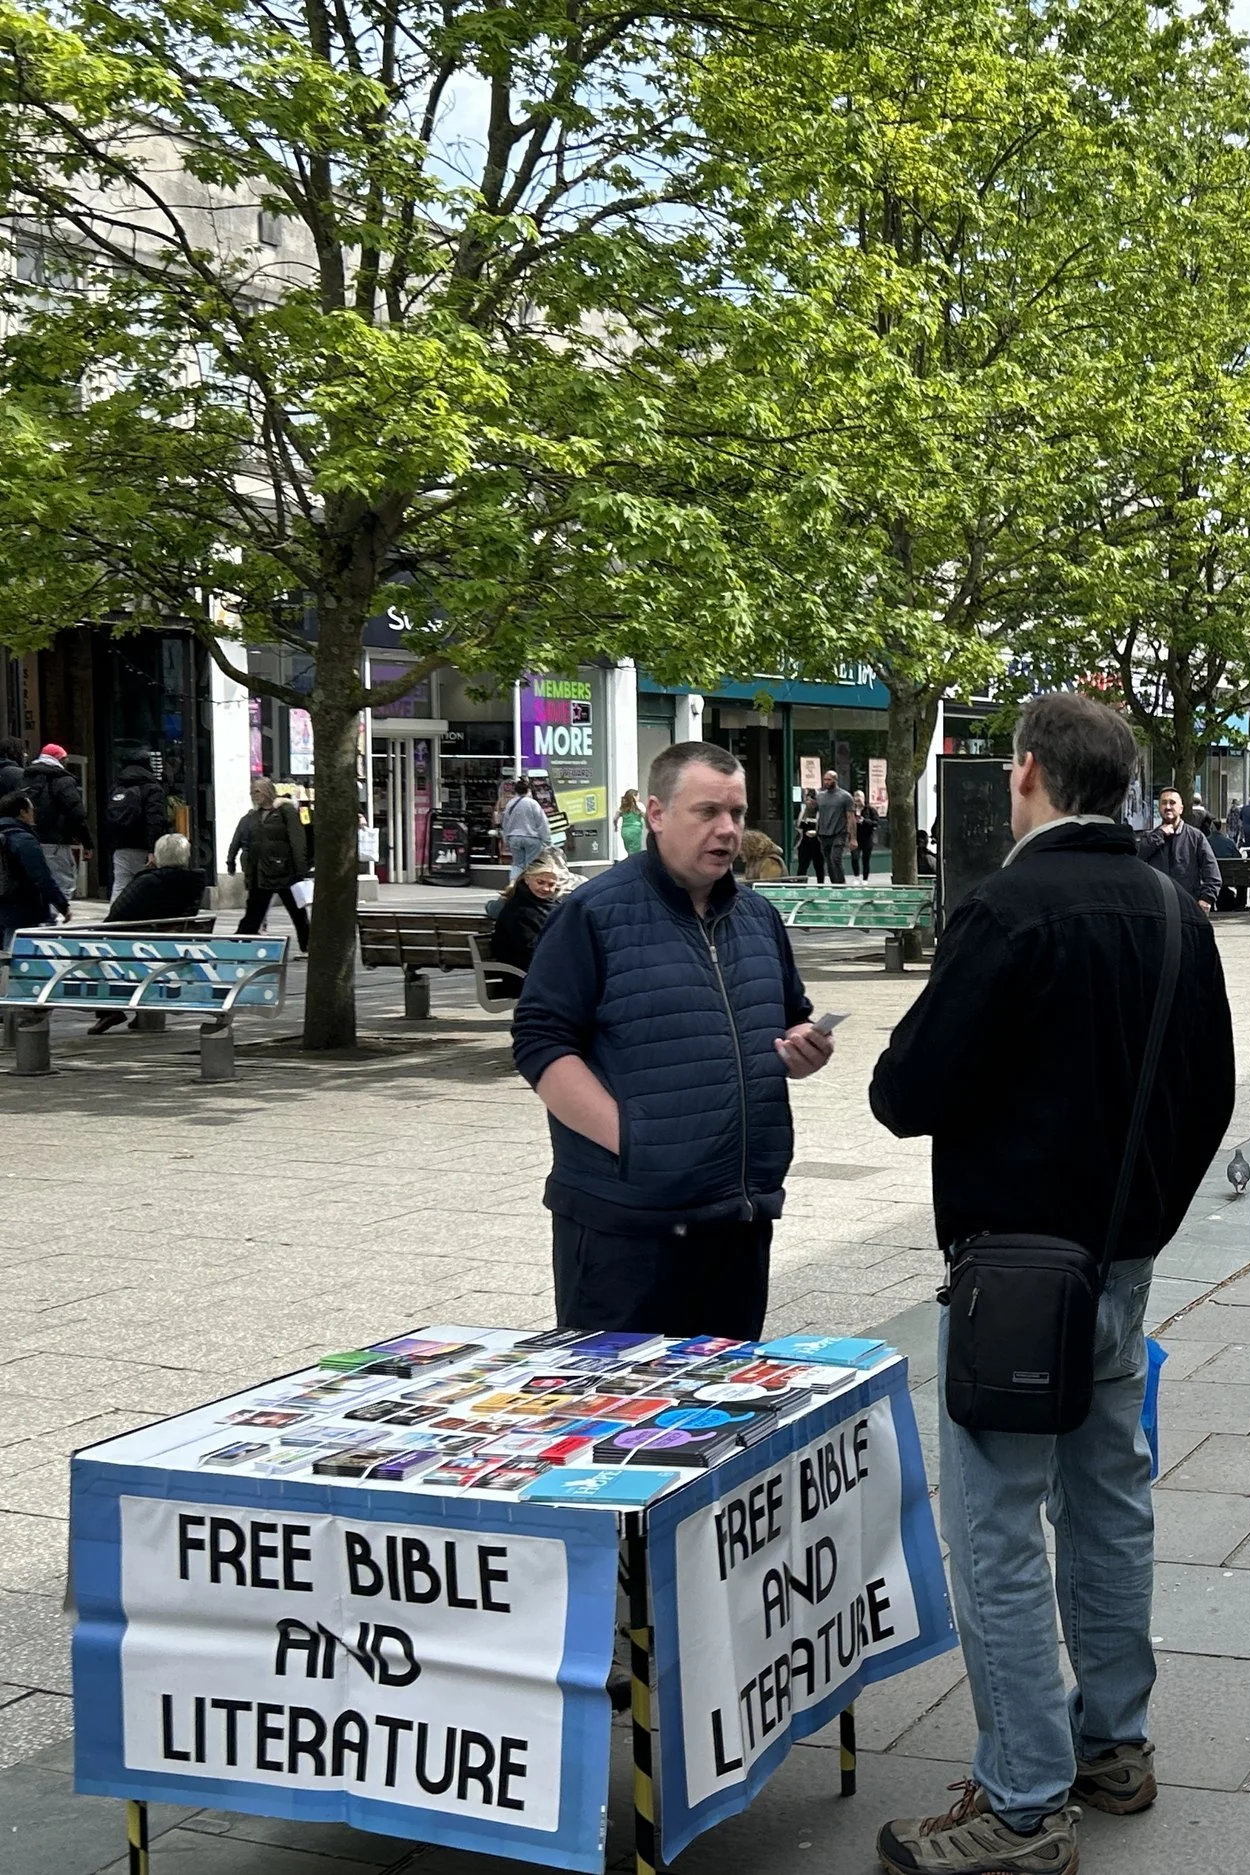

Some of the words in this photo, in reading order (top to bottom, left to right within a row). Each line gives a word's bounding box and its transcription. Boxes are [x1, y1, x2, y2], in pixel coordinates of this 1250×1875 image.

[533, 700, 570, 725] SAVE
[534, 679, 592, 700] MEMBERS
[534, 725, 593, 756] MORE
[572, 1469, 624, 1496] HOPE
[714, 1474, 783, 1582] FREE
[800, 1419, 869, 1524] BIBLE
[178, 1513, 314, 1592] FREE
[345, 1531, 511, 1613] BIBLE
[763, 1536, 838, 1640] AND
[275, 1617, 422, 1688] AND
[711, 1577, 895, 1777] LTERATURE
[162, 1694, 529, 1811] LITERATURE
